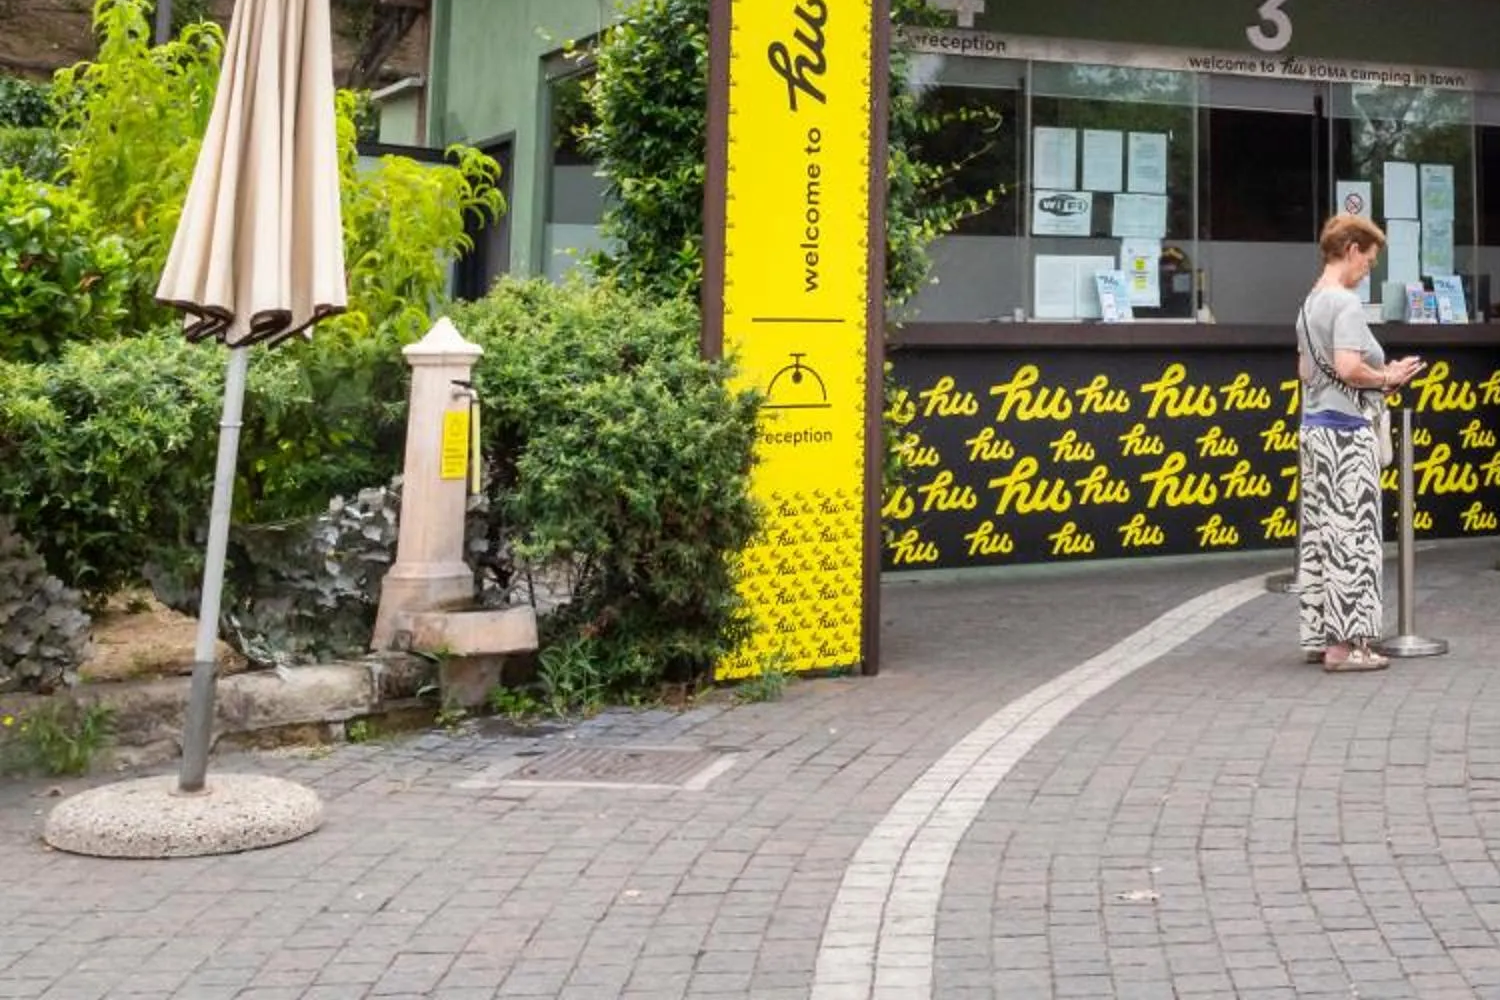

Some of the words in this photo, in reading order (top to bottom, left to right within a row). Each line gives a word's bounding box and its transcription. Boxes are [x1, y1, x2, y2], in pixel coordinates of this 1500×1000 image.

[920, 34, 1006, 52] reception
[1188, 56, 1257, 73] welcome
[1261, 60, 1275, 73] to
[1351, 68, 1410, 86] camping
[1415, 70, 1426, 85] in
[1429, 72, 1466, 87] town
[806, 127, 820, 155] to
[801, 164, 820, 292] welcome
[919, 376, 979, 417] hu
[989, 364, 1073, 423] hu
[1075, 375, 1131, 414] hu
[1140, 363, 1218, 419] hu
[1219, 372, 1271, 411] hu
[1410, 361, 1476, 413] hu
[965, 426, 1015, 462] hu
[1049, 429, 1096, 463] hu
[1119, 422, 1165, 456] hu
[1195, 425, 1239, 458] hu
[1459, 419, 1496, 449] hu
[918, 470, 978, 512] hu
[988, 457, 1072, 515] hu
[1074, 465, 1131, 505] hu
[1140, 451, 1218, 509] hu
[1219, 459, 1272, 499] hu
[1413, 443, 1478, 495] hu
[889, 529, 939, 565] hu
[964, 520, 1014, 556] hu
[1048, 521, 1095, 555] hu
[1119, 513, 1164, 547] hu
[1196, 514, 1239, 547] hu
[1460, 501, 1497, 531] hu
